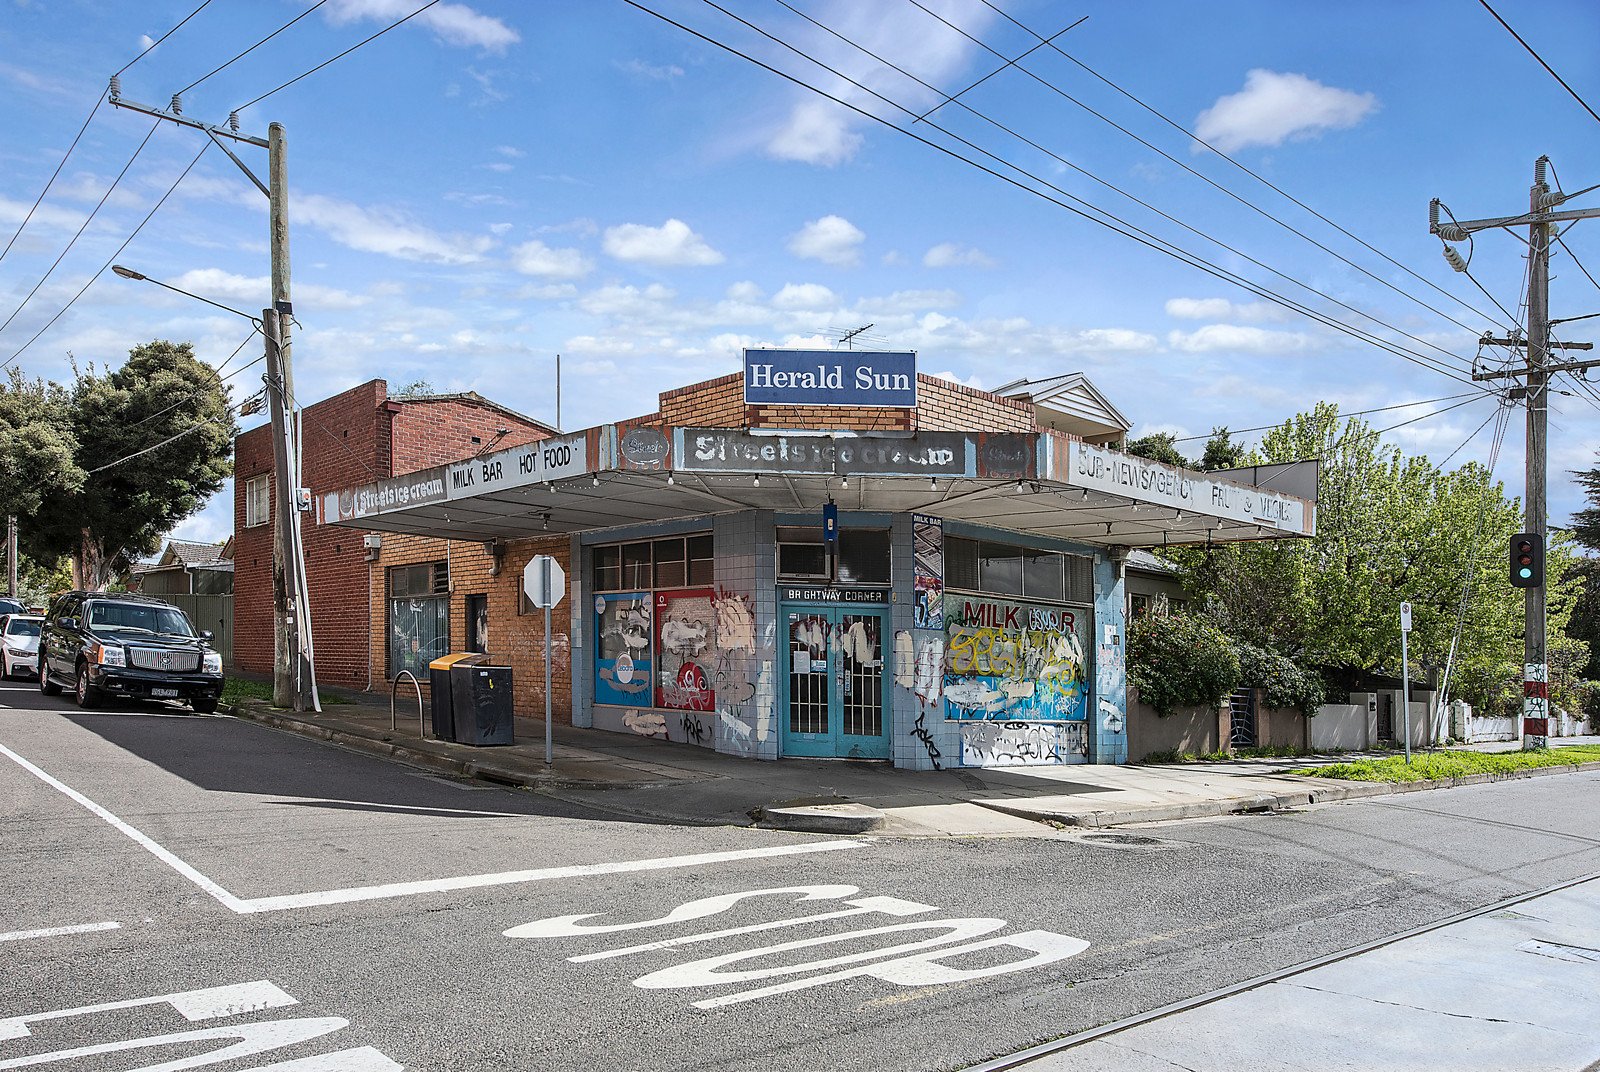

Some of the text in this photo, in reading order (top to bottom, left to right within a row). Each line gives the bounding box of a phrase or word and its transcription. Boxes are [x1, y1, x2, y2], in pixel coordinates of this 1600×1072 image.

[750, 364, 911, 391] Herald Sun
[695, 433, 806, 462] Streets
[453, 445, 571, 490] MILK BAR HOT FOOD
[360, 478, 443, 512] Streets ice cream
[1211, 485, 1240, 510] FRU
[914, 515, 942, 526] MILK BAR
[788, 590, 882, 601] BRGHTWAY CORNER
[964, 601, 1021, 630] MILK
[502, 884, 1090, 1010] STOP
